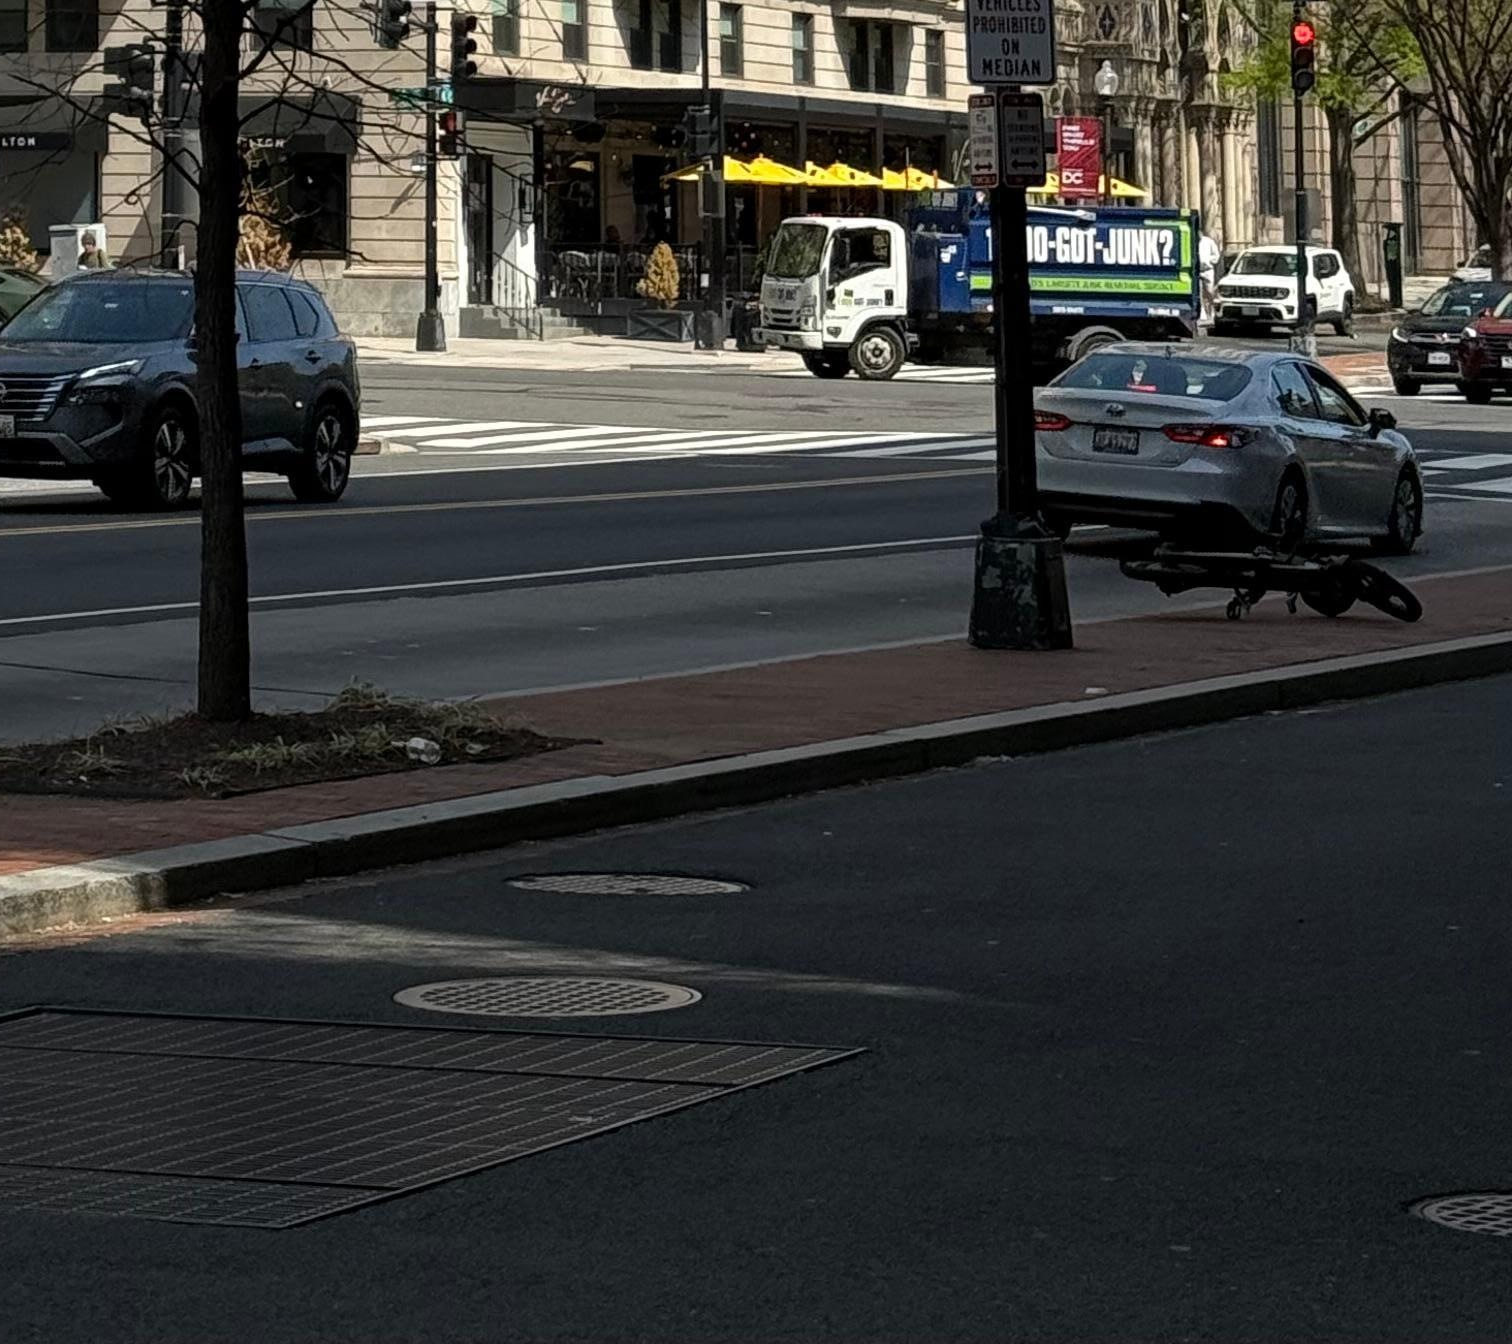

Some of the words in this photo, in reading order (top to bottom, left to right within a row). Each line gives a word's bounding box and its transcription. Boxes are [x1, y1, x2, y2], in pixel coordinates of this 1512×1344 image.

[973, 16, 1046, 34] PROHIBITED
[1001, 38, 1020, 56] ON
[982, 58, 1041, 76] MEDIAN
[1062, 172, 1084, 184] DC
